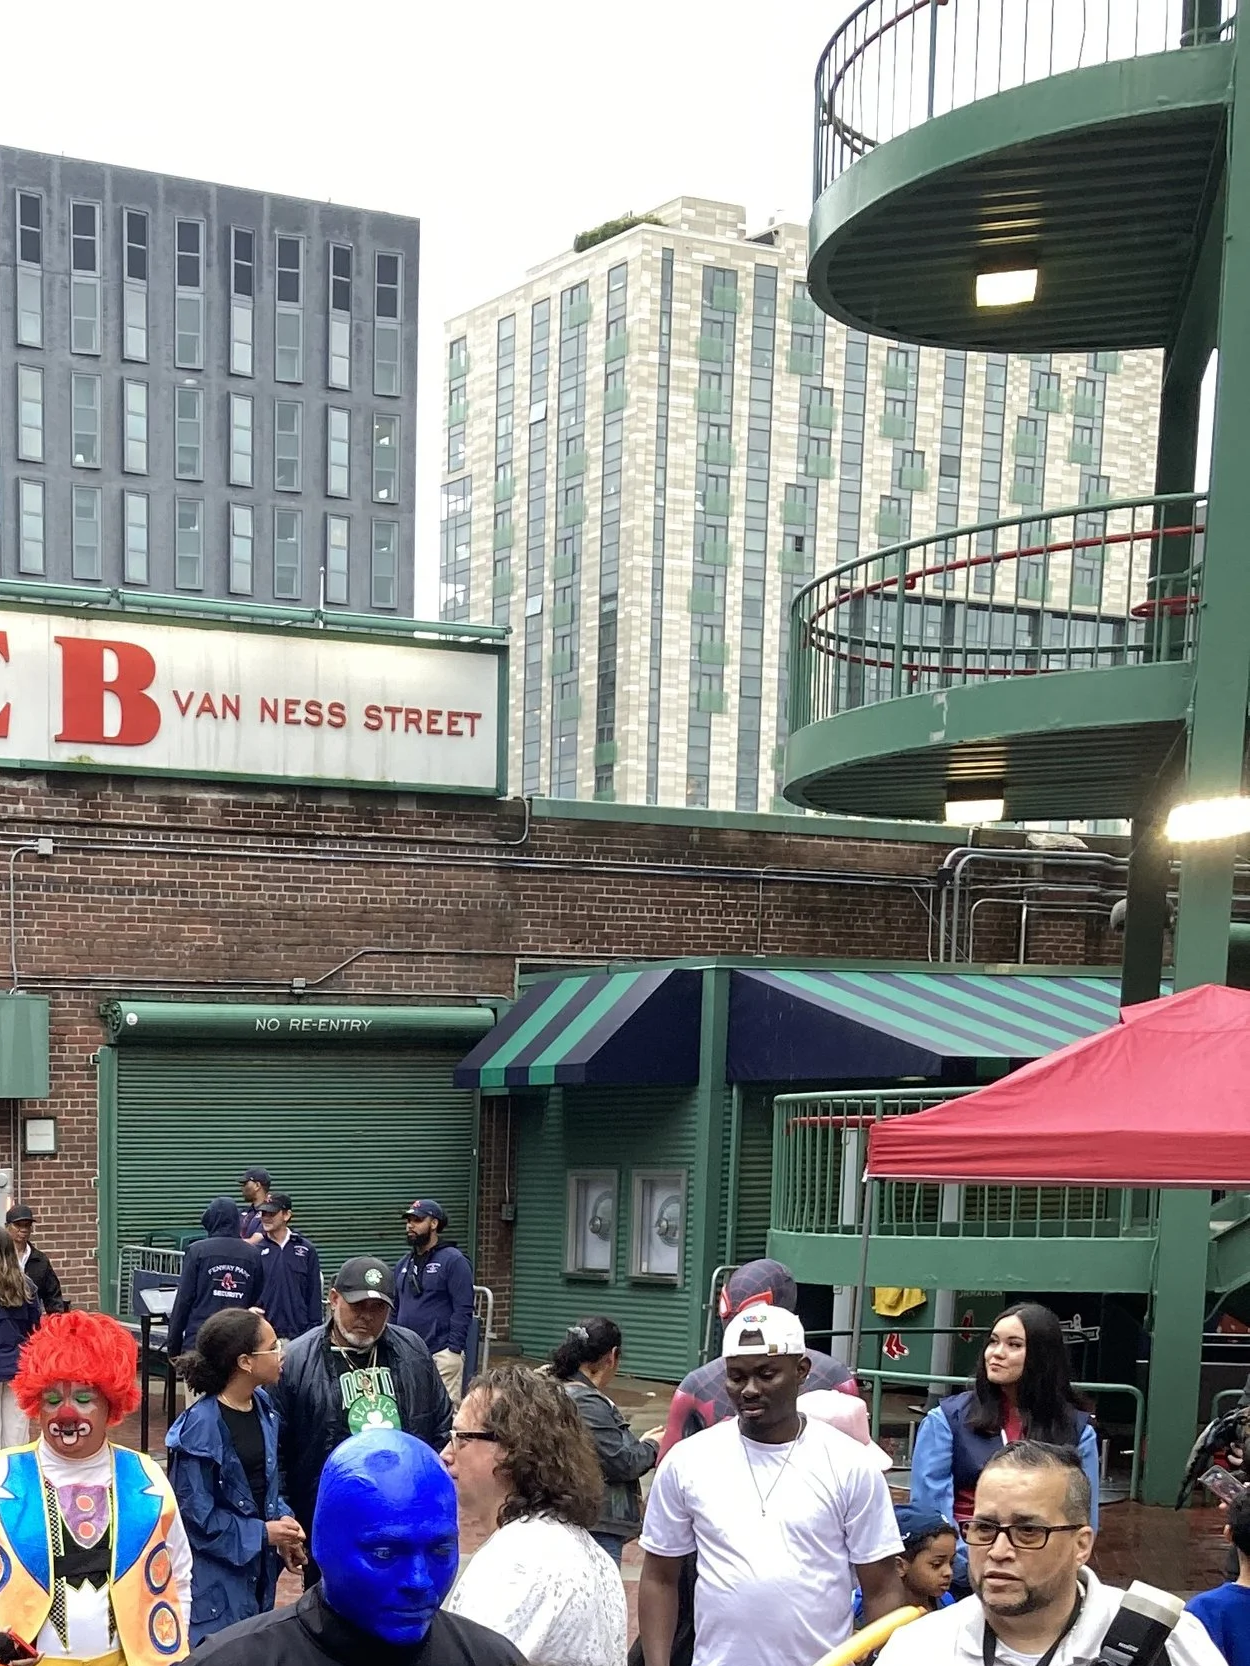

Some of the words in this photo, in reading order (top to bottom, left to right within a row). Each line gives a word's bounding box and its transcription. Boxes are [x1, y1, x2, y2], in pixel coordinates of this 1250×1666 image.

[54, 635, 162, 747] B
[172, 690, 241, 722] VAN
[260, 698, 347, 730] NESS
[364, 704, 483, 738] STREET
[255, 1018, 280, 1032] NO
[288, 1018, 373, 1032] RE-ENTRY
[208, 1264, 235, 1276] FENWAY
[213, 1289, 244, 1299] SECURITY
[351, 1398, 398, 1422] CELTICS
